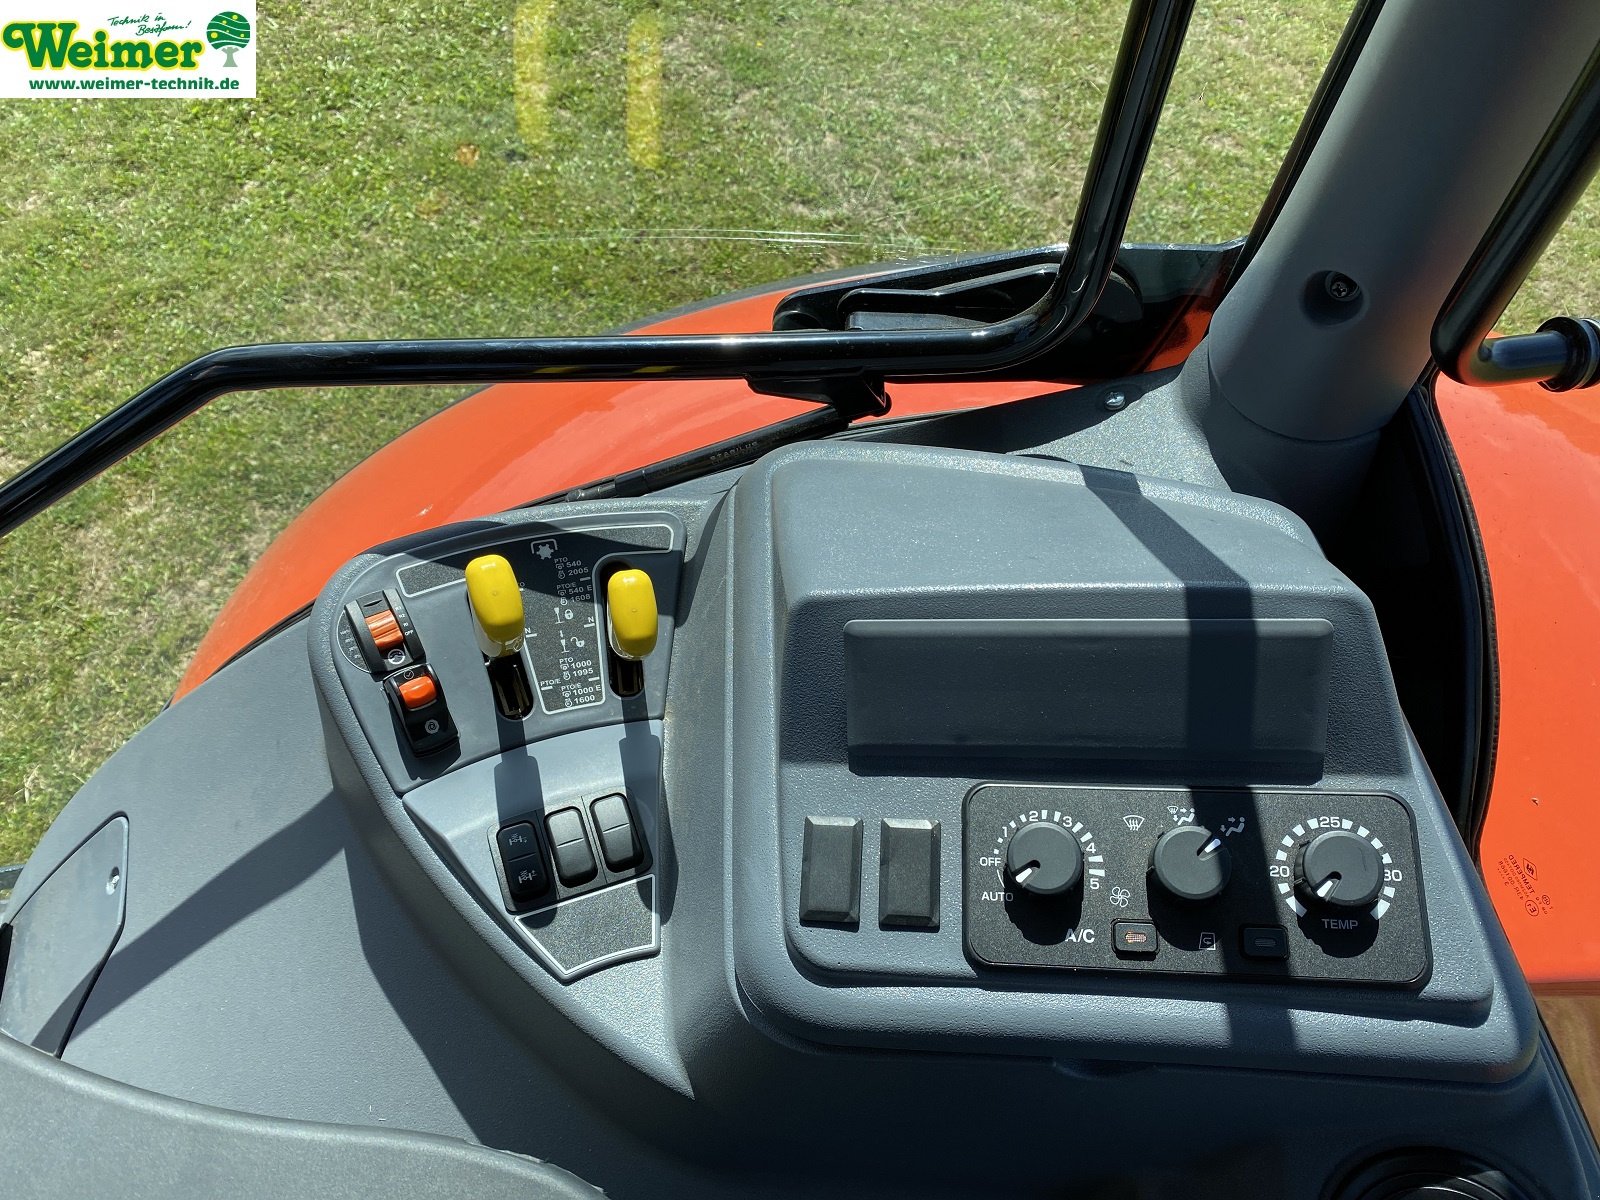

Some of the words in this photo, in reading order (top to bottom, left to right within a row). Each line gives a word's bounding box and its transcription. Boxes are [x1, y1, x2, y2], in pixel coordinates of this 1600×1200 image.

[566, 560, 582, 568] 540
[568, 567, 589, 576] 2005
[569, 586, 584, 595] 540
[570, 594, 591, 603] 1608
[571, 660, 592, 669] 1000
[572, 668, 594, 677] 1995
[572, 686, 594, 696] 1000
[595, 684, 602, 692] E
[573, 695, 595, 704] 1600
[1029, 810, 1039, 822] 2
[1062, 816, 1073, 828] 3
[1319, 816, 1341, 828] 25
[1001, 826, 1008, 838] 1
[1086, 842, 1096, 854] 4
[979, 857, 1001, 867] OFF
[1269, 865, 1290, 877] 20
[1383, 869, 1402, 882] 30
[1089, 878, 1100, 890] 5
[981, 891, 1014, 902] AUTO
[1321, 918, 1359, 930] TEMP
[1064, 928, 1096, 944] A/C
